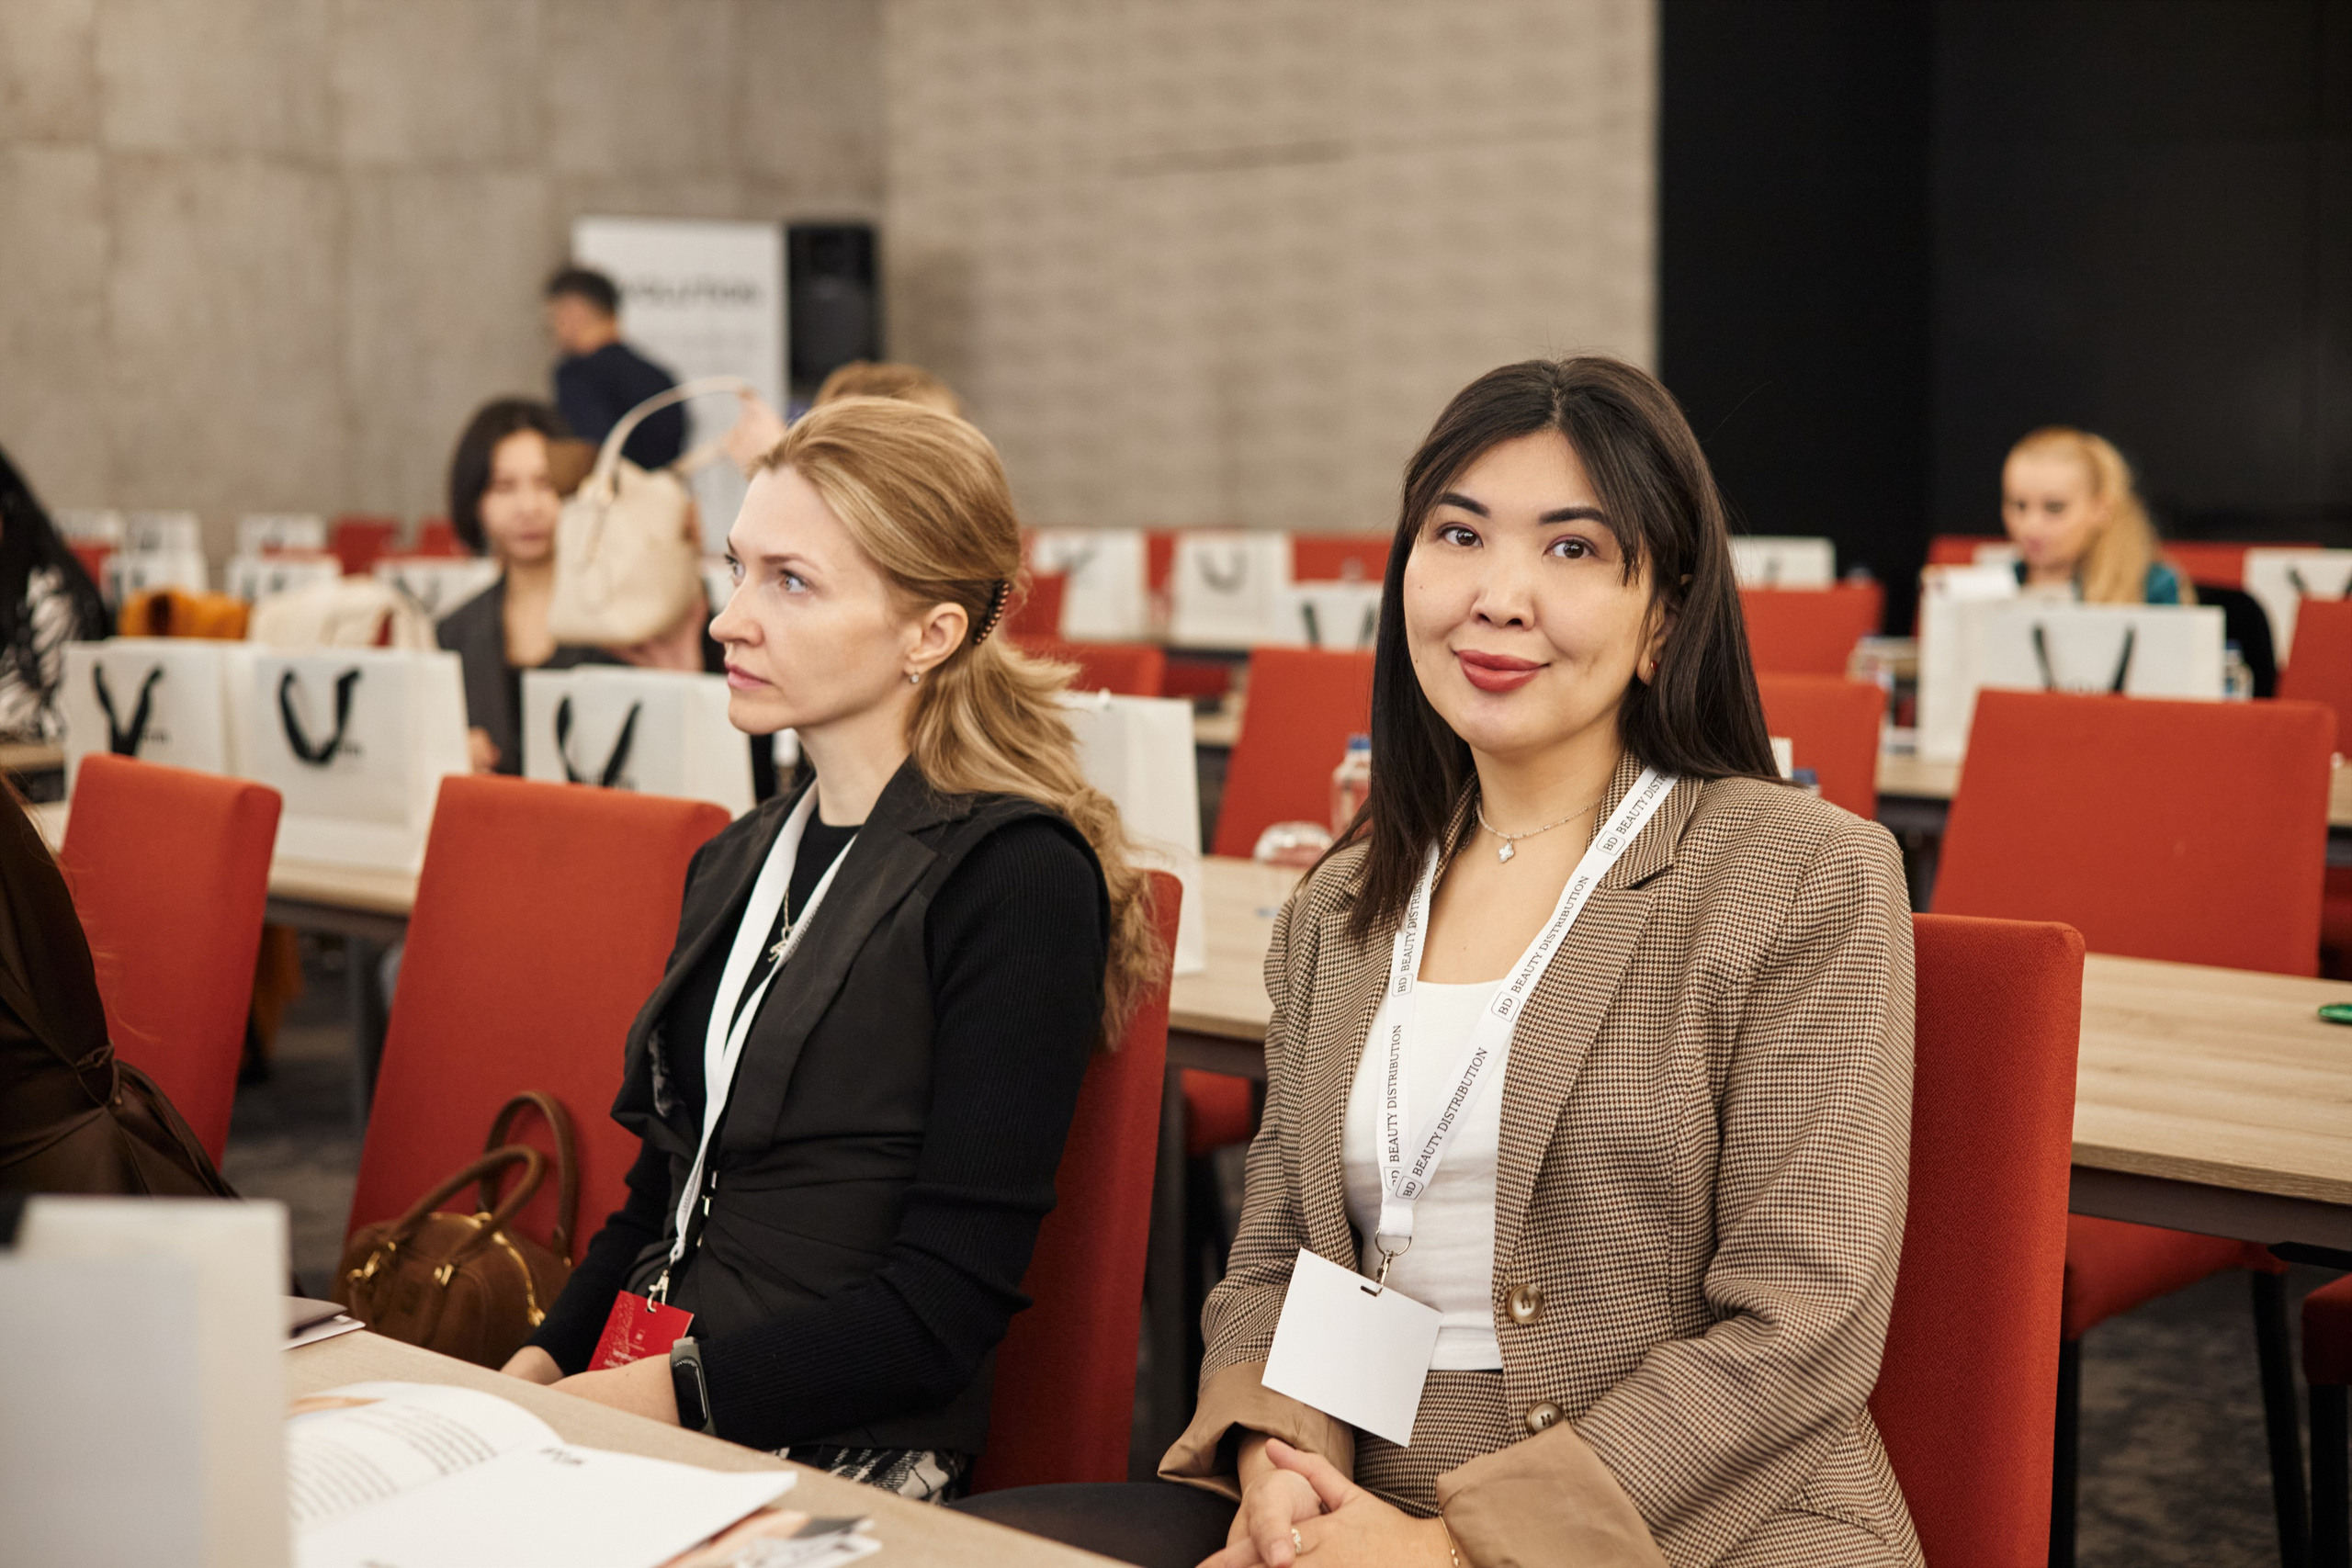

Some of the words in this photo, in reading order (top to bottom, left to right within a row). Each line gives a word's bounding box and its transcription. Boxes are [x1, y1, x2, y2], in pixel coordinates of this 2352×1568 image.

[1603, 837, 1618, 852] BD
[1616, 796, 1647, 835] BEAUTY
[1401, 931, 1416, 973] BEAUTY
[1498, 998, 1513, 1016] BD
[1510, 952, 1543, 994] BEAUTY
[1539, 875, 1589, 951] DISTRIBUTION
[1397, 976, 1408, 993] BD
[1386, 1024, 1402, 1109] DISTRIBUTION
[1386, 1113, 1400, 1163] BEAUTY
[1403, 1181, 1417, 1197] BD
[1412, 1132, 1443, 1178] BEAUTY
[1437, 1046, 1488, 1133] DISTRIBUTION
